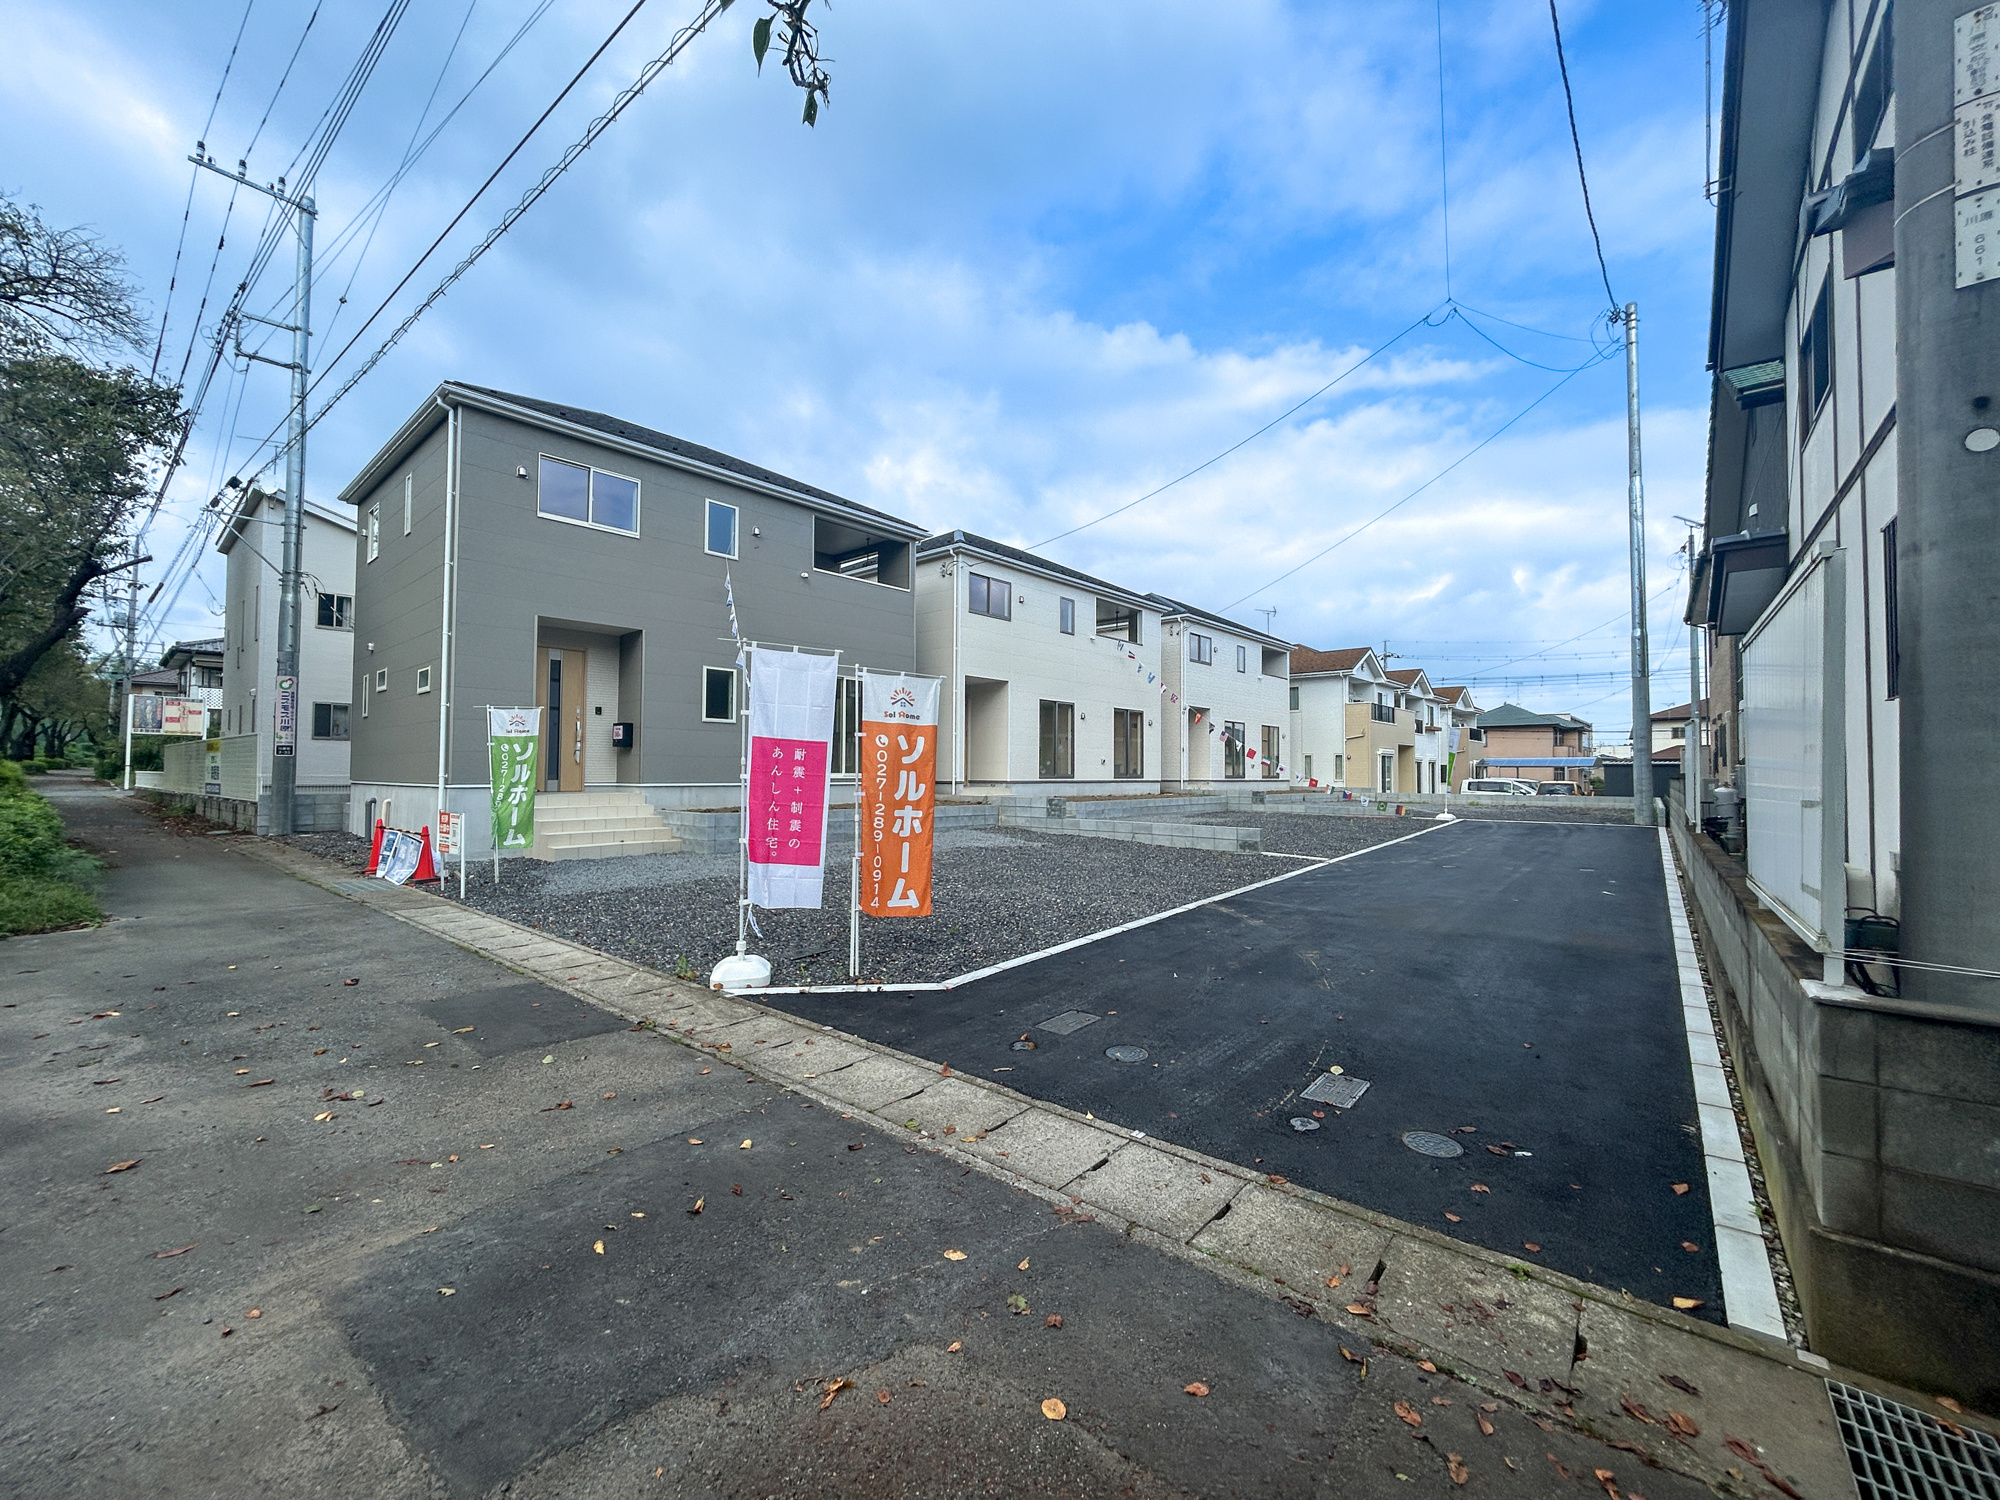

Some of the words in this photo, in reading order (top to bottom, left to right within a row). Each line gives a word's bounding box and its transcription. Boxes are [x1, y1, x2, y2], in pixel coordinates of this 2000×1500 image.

[503, 742, 534, 846] ソルホーム
[766, 747, 784, 857] あんしん住宅。
[871, 750, 888, 908] 027-289-0914
[887, 734, 926, 909] ソルホーム
